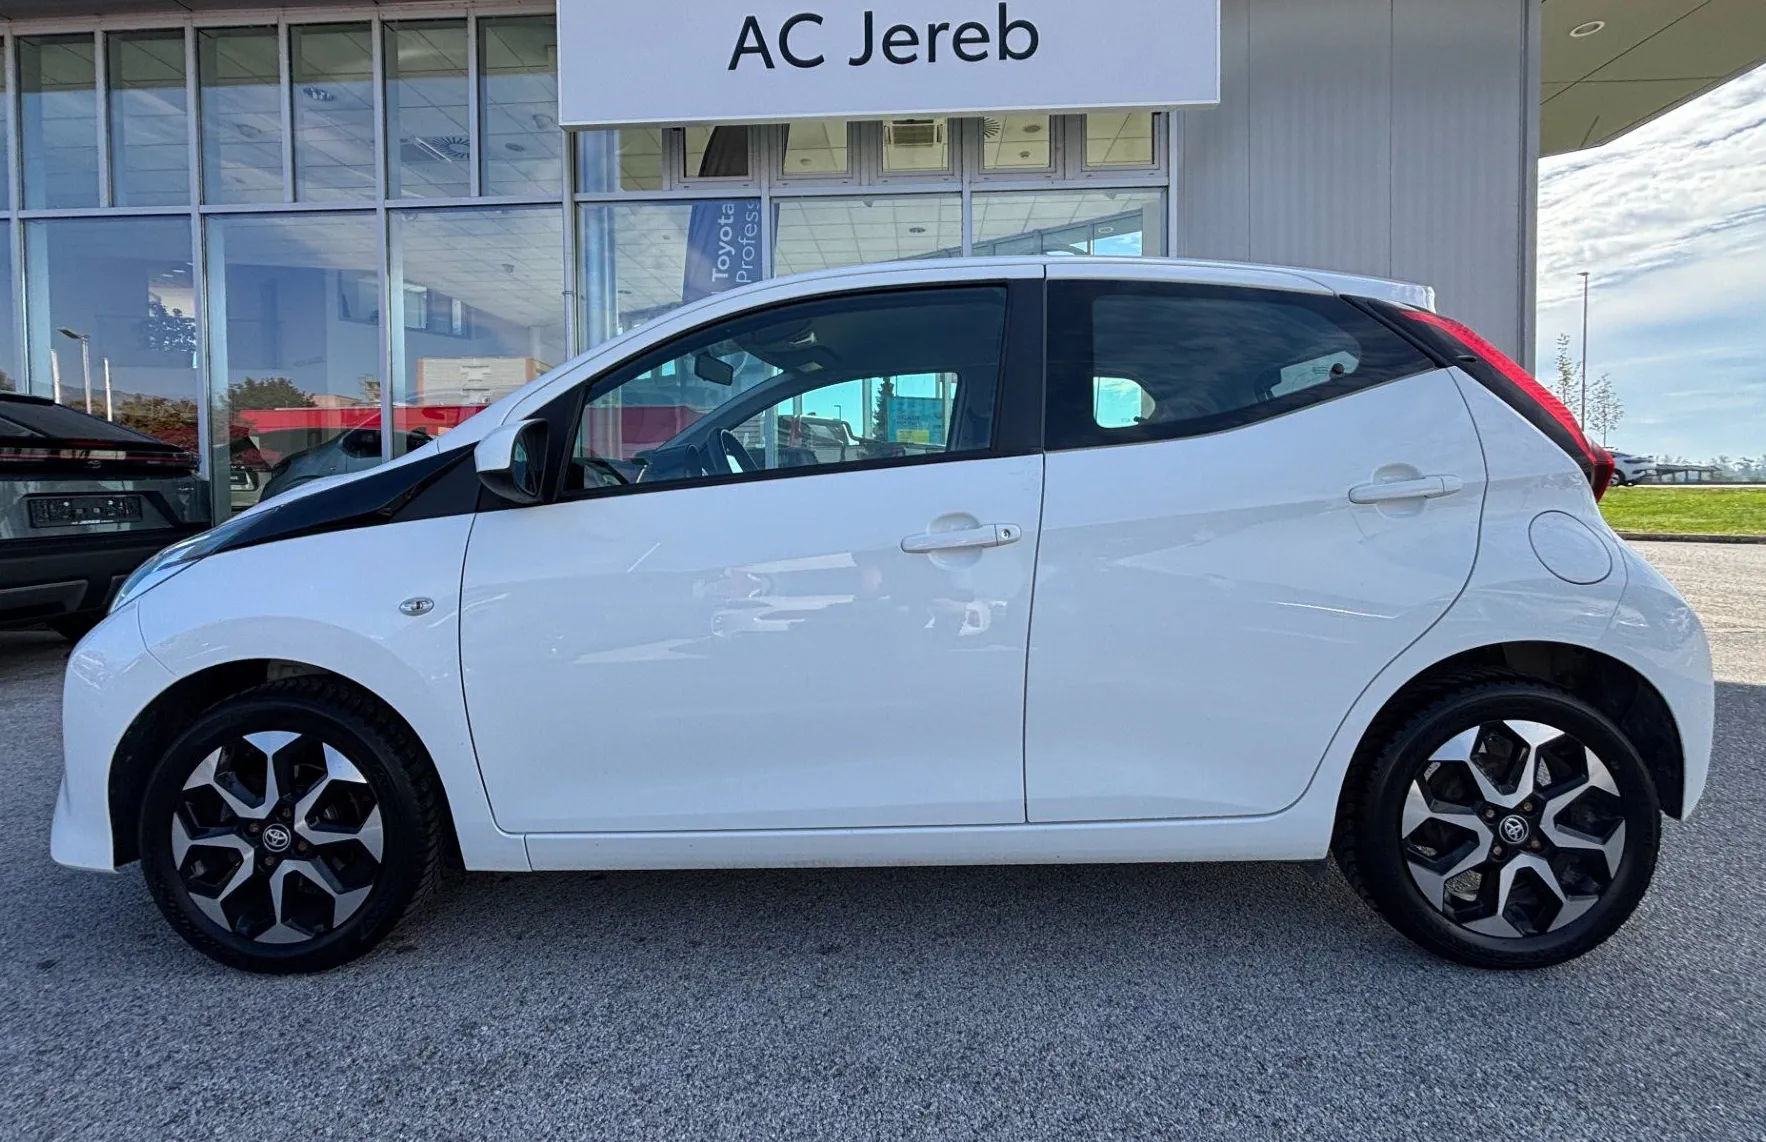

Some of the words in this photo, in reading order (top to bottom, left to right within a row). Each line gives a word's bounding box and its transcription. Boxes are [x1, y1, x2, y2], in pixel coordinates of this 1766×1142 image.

[727, 12, 825, 71] AC
[848, 2, 1039, 67] Jereb
[711, 202, 735, 282] Toyota
